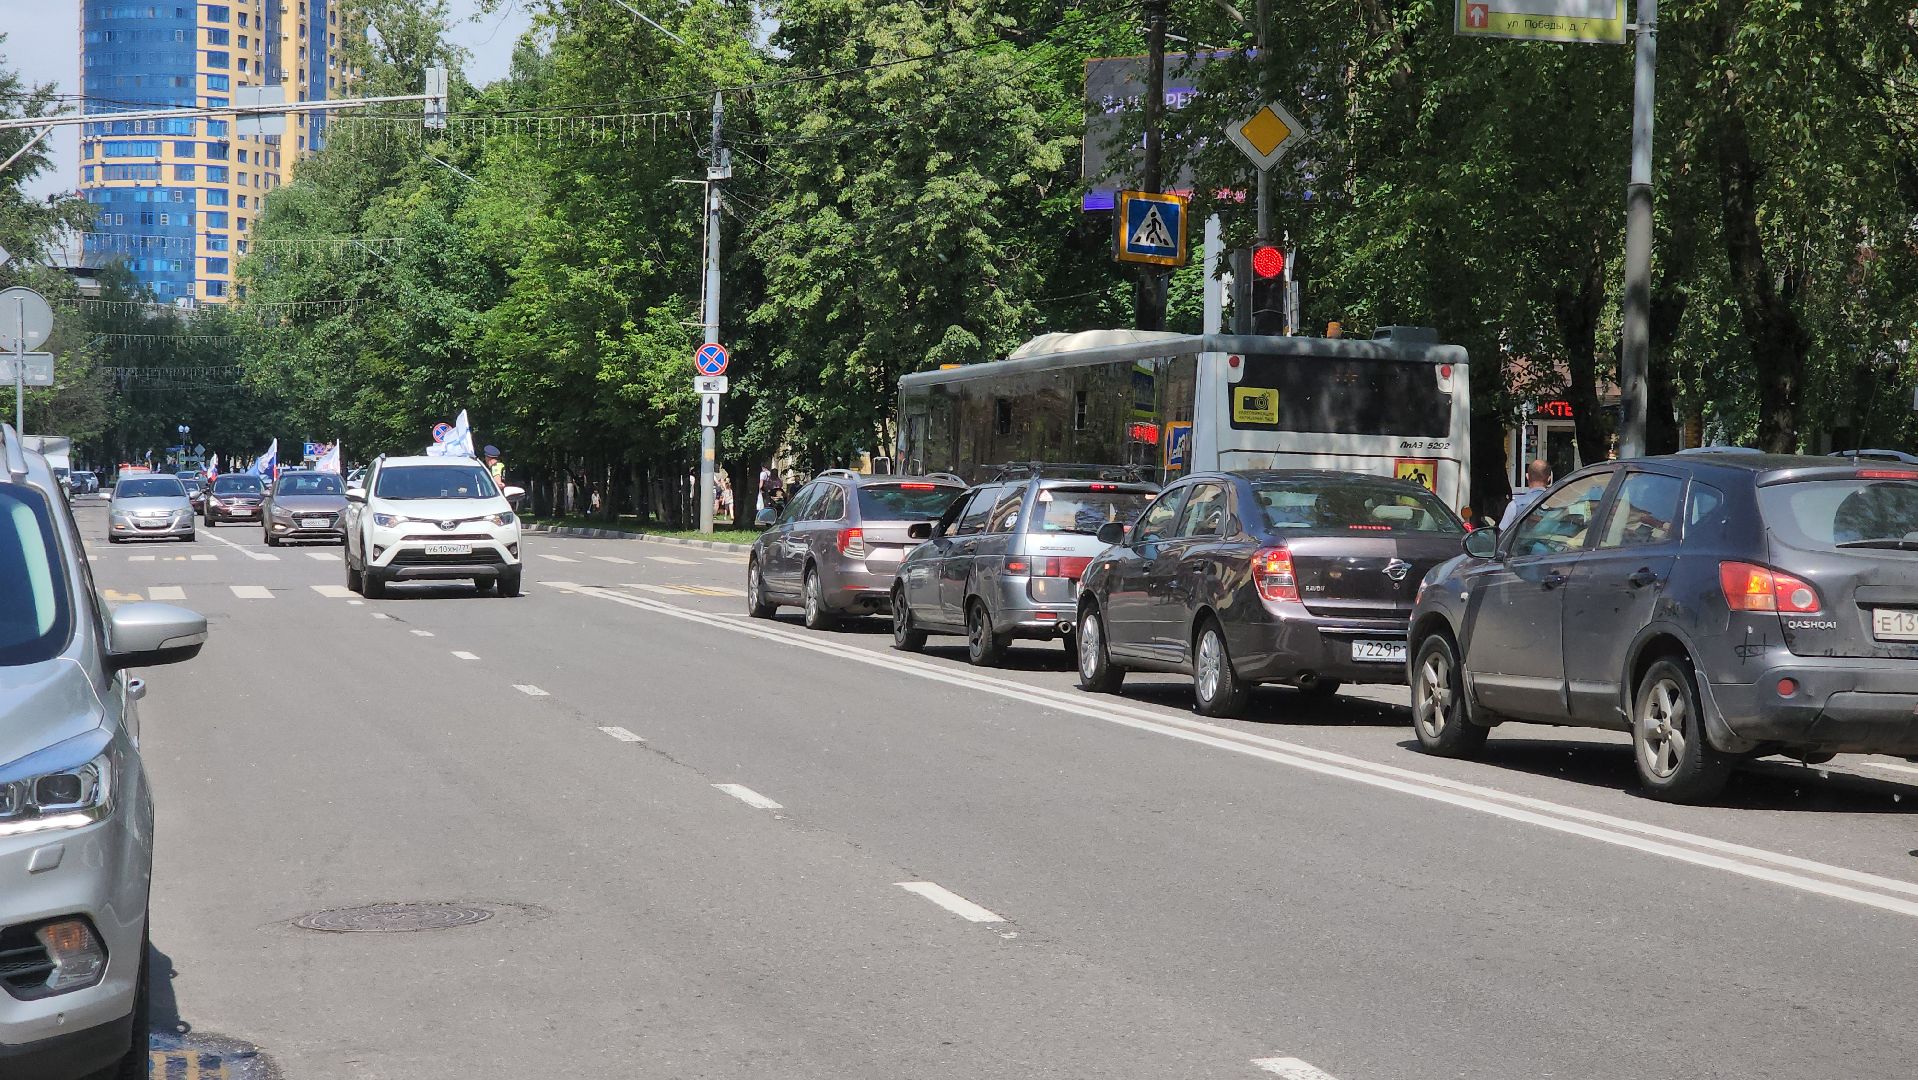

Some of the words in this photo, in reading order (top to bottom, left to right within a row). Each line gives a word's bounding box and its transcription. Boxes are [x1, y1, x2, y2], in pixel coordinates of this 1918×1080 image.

[1524, 20, 1567, 31] Победы,
[1582, 23, 1588, 32] 7
[1427, 442, 1450, 450] 5292
[1788, 620, 1837, 629] QASHQAI
[1881, 613, 1918, 632] Е13
